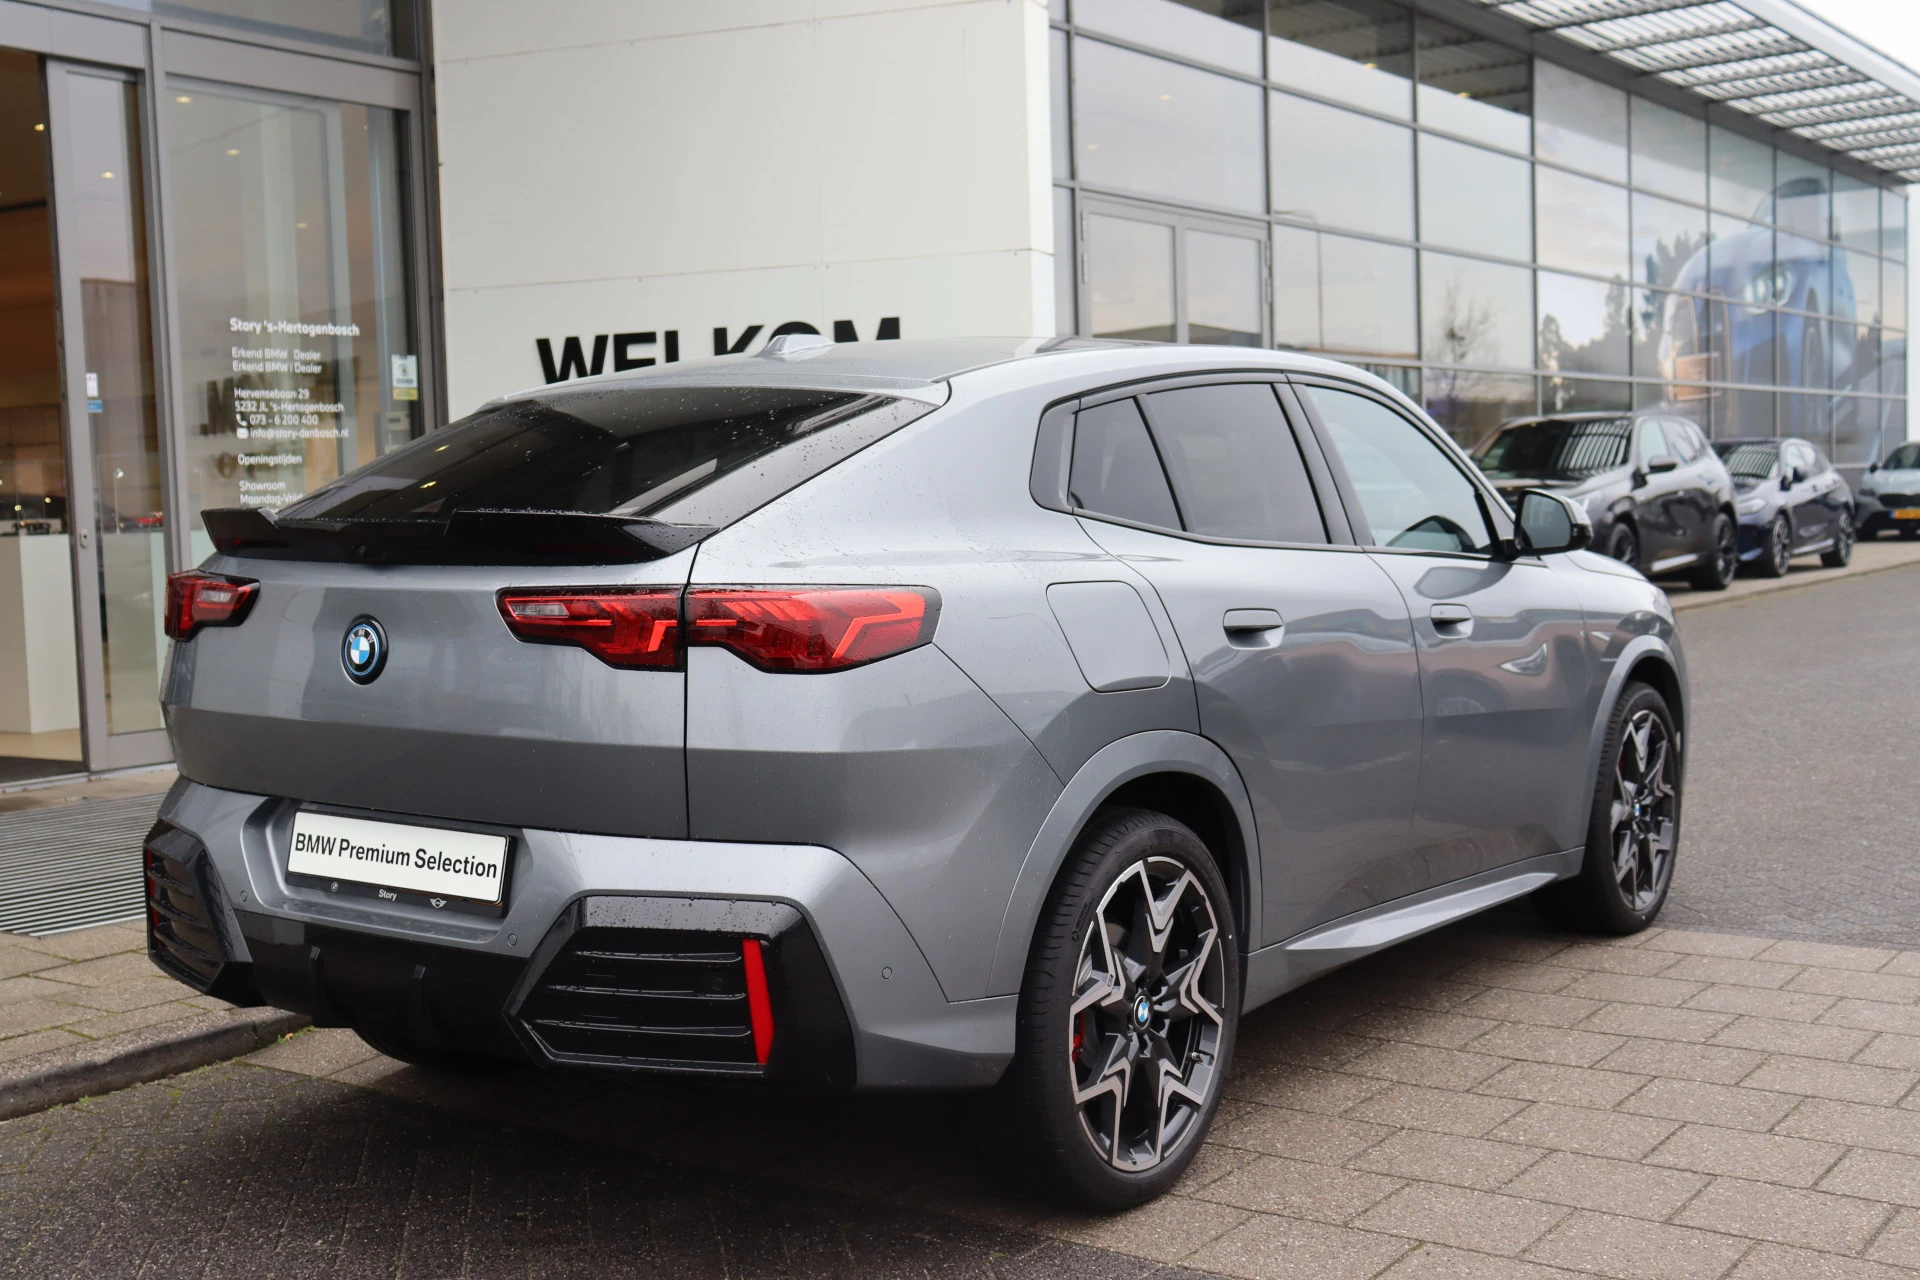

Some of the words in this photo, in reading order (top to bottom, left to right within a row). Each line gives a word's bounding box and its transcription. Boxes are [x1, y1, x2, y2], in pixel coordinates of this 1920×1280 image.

[229, 317, 262, 335] Story
[263, 320, 361, 337] 's-Hertogenbosch
[231, 346, 263, 360] Erkend
[264, 347, 288, 359] BMW
[293, 348, 322, 361] Dealer
[232, 360, 264, 373] Erkend
[264, 361, 288, 373] BMW
[294, 362, 323, 374] Dealer
[233, 387, 297, 399] Hervensebaan
[298, 388, 311, 399] 29
[234, 400, 258, 413] 5232
[258, 401, 269, 413] JL
[269, 401, 345, 414] 's-Hertogenbosch
[249, 414, 267, 426] 073
[273, 415, 281, 426] 6
[281, 414, 301, 426] 200
[301, 414, 320, 426] 400
[250, 427, 349, 440] info@story-denbosch.nl
[237, 453, 304, 467] Openingstijden
[238, 480, 286, 492] Showroom
[294, 831, 337, 857] BMW
[337, 837, 411, 867] Premium
[413, 847, 498, 879] Selection
[378, 888, 398, 902] Story
